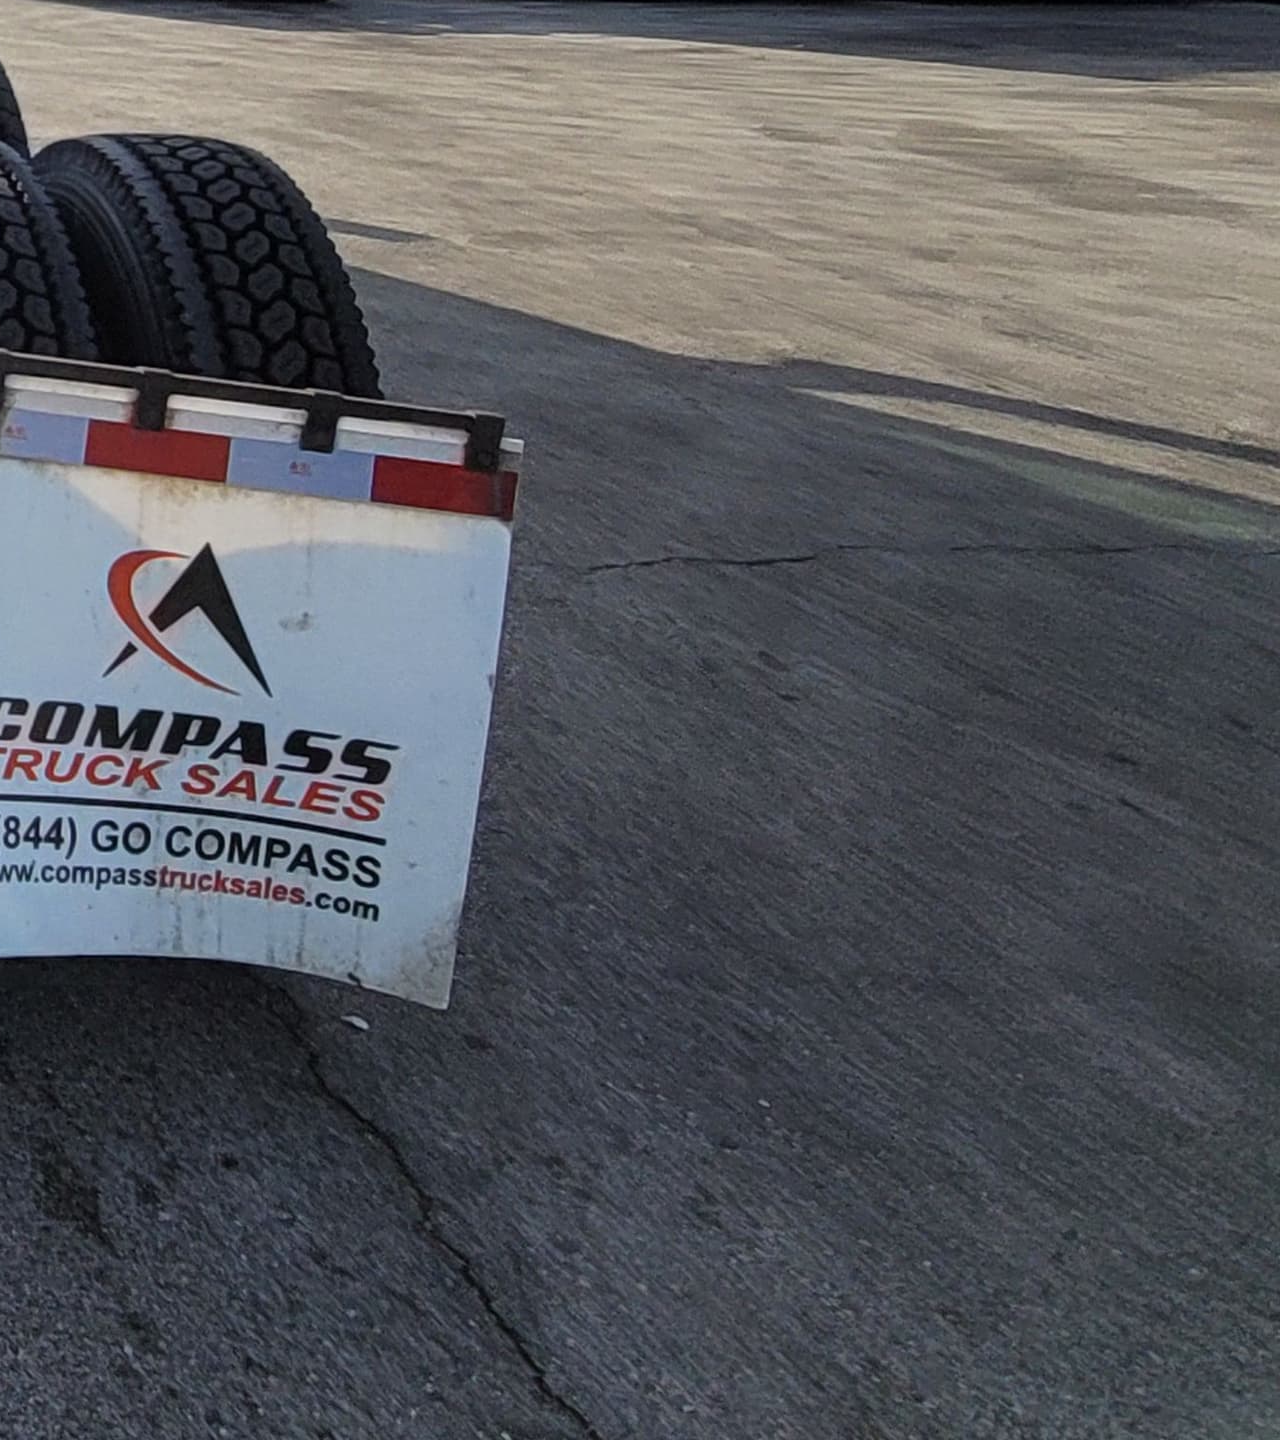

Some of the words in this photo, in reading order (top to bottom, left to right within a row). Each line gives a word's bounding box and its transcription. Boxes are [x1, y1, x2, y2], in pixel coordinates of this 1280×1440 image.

[181, 764, 386, 822] SALES
[91, 820, 151, 855] GO
[165, 825, 382, 889] COMPASS
